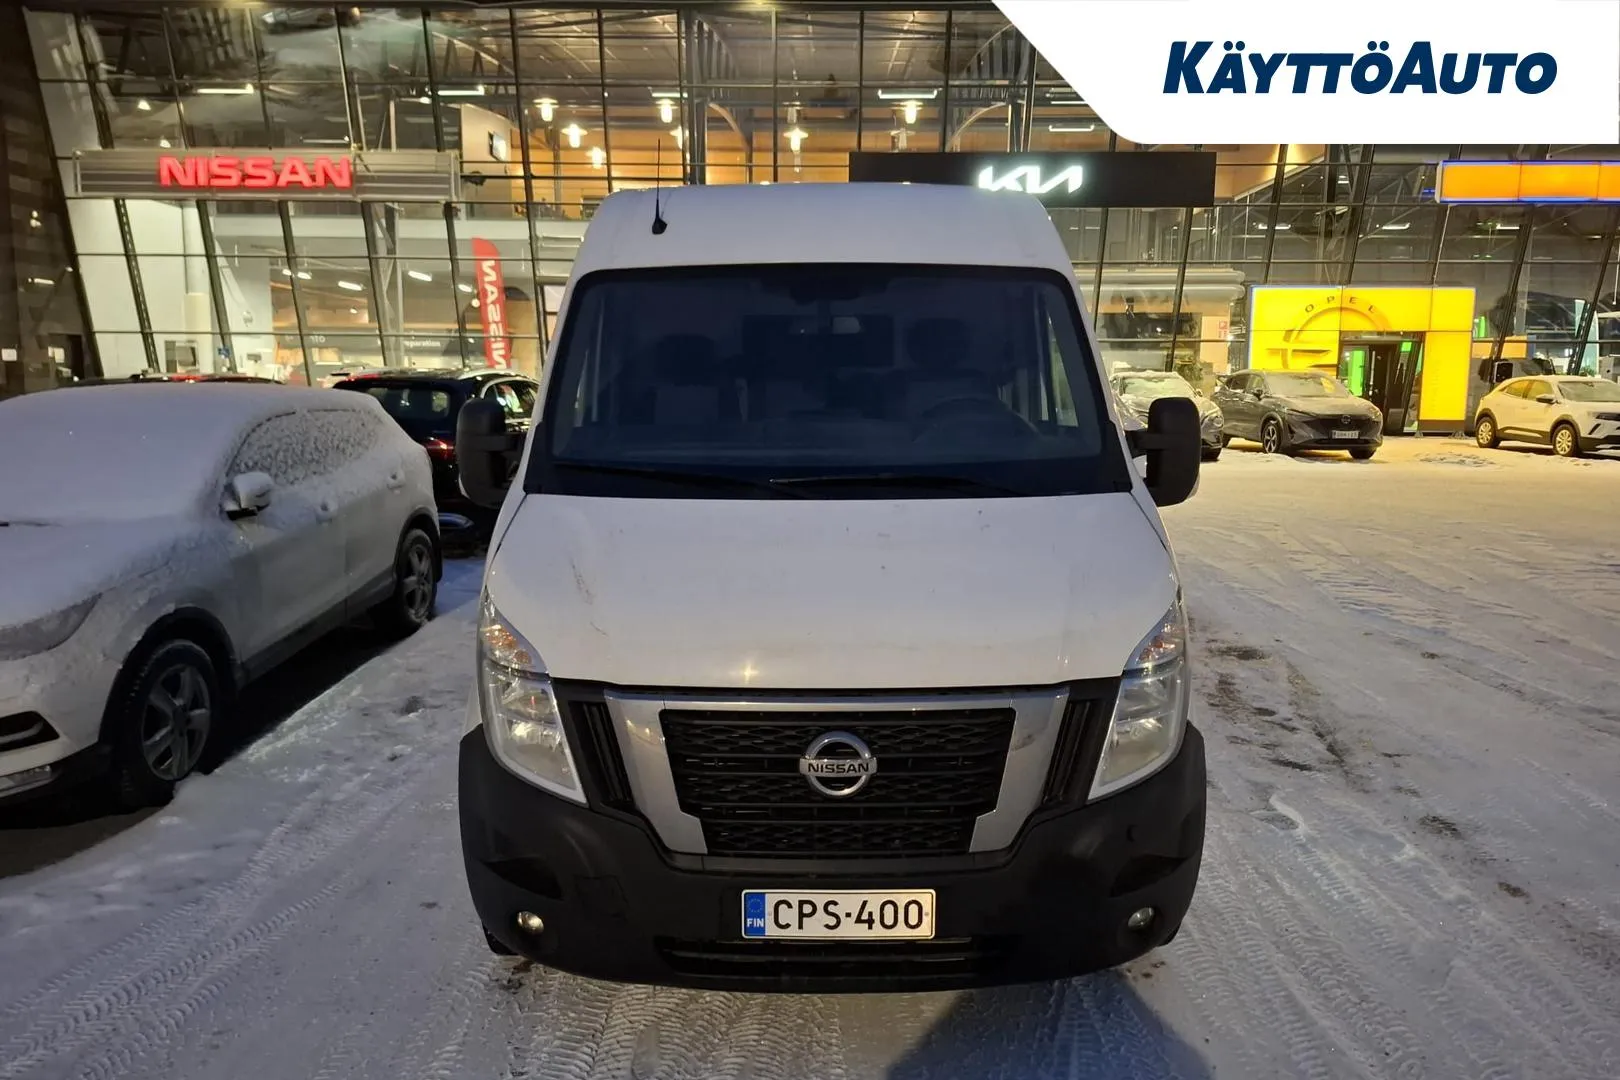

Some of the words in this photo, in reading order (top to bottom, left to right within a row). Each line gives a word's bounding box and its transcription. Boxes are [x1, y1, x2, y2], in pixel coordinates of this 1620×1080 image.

[159, 155, 352, 188] NISSAN
[978, 164, 1083, 194] KIA
[1305, 295, 1376, 314] OPEL
[807, 762, 869, 774] NISSAN
[746, 917, 765, 928] FIN
[773, 899, 924, 930] CPS-400
